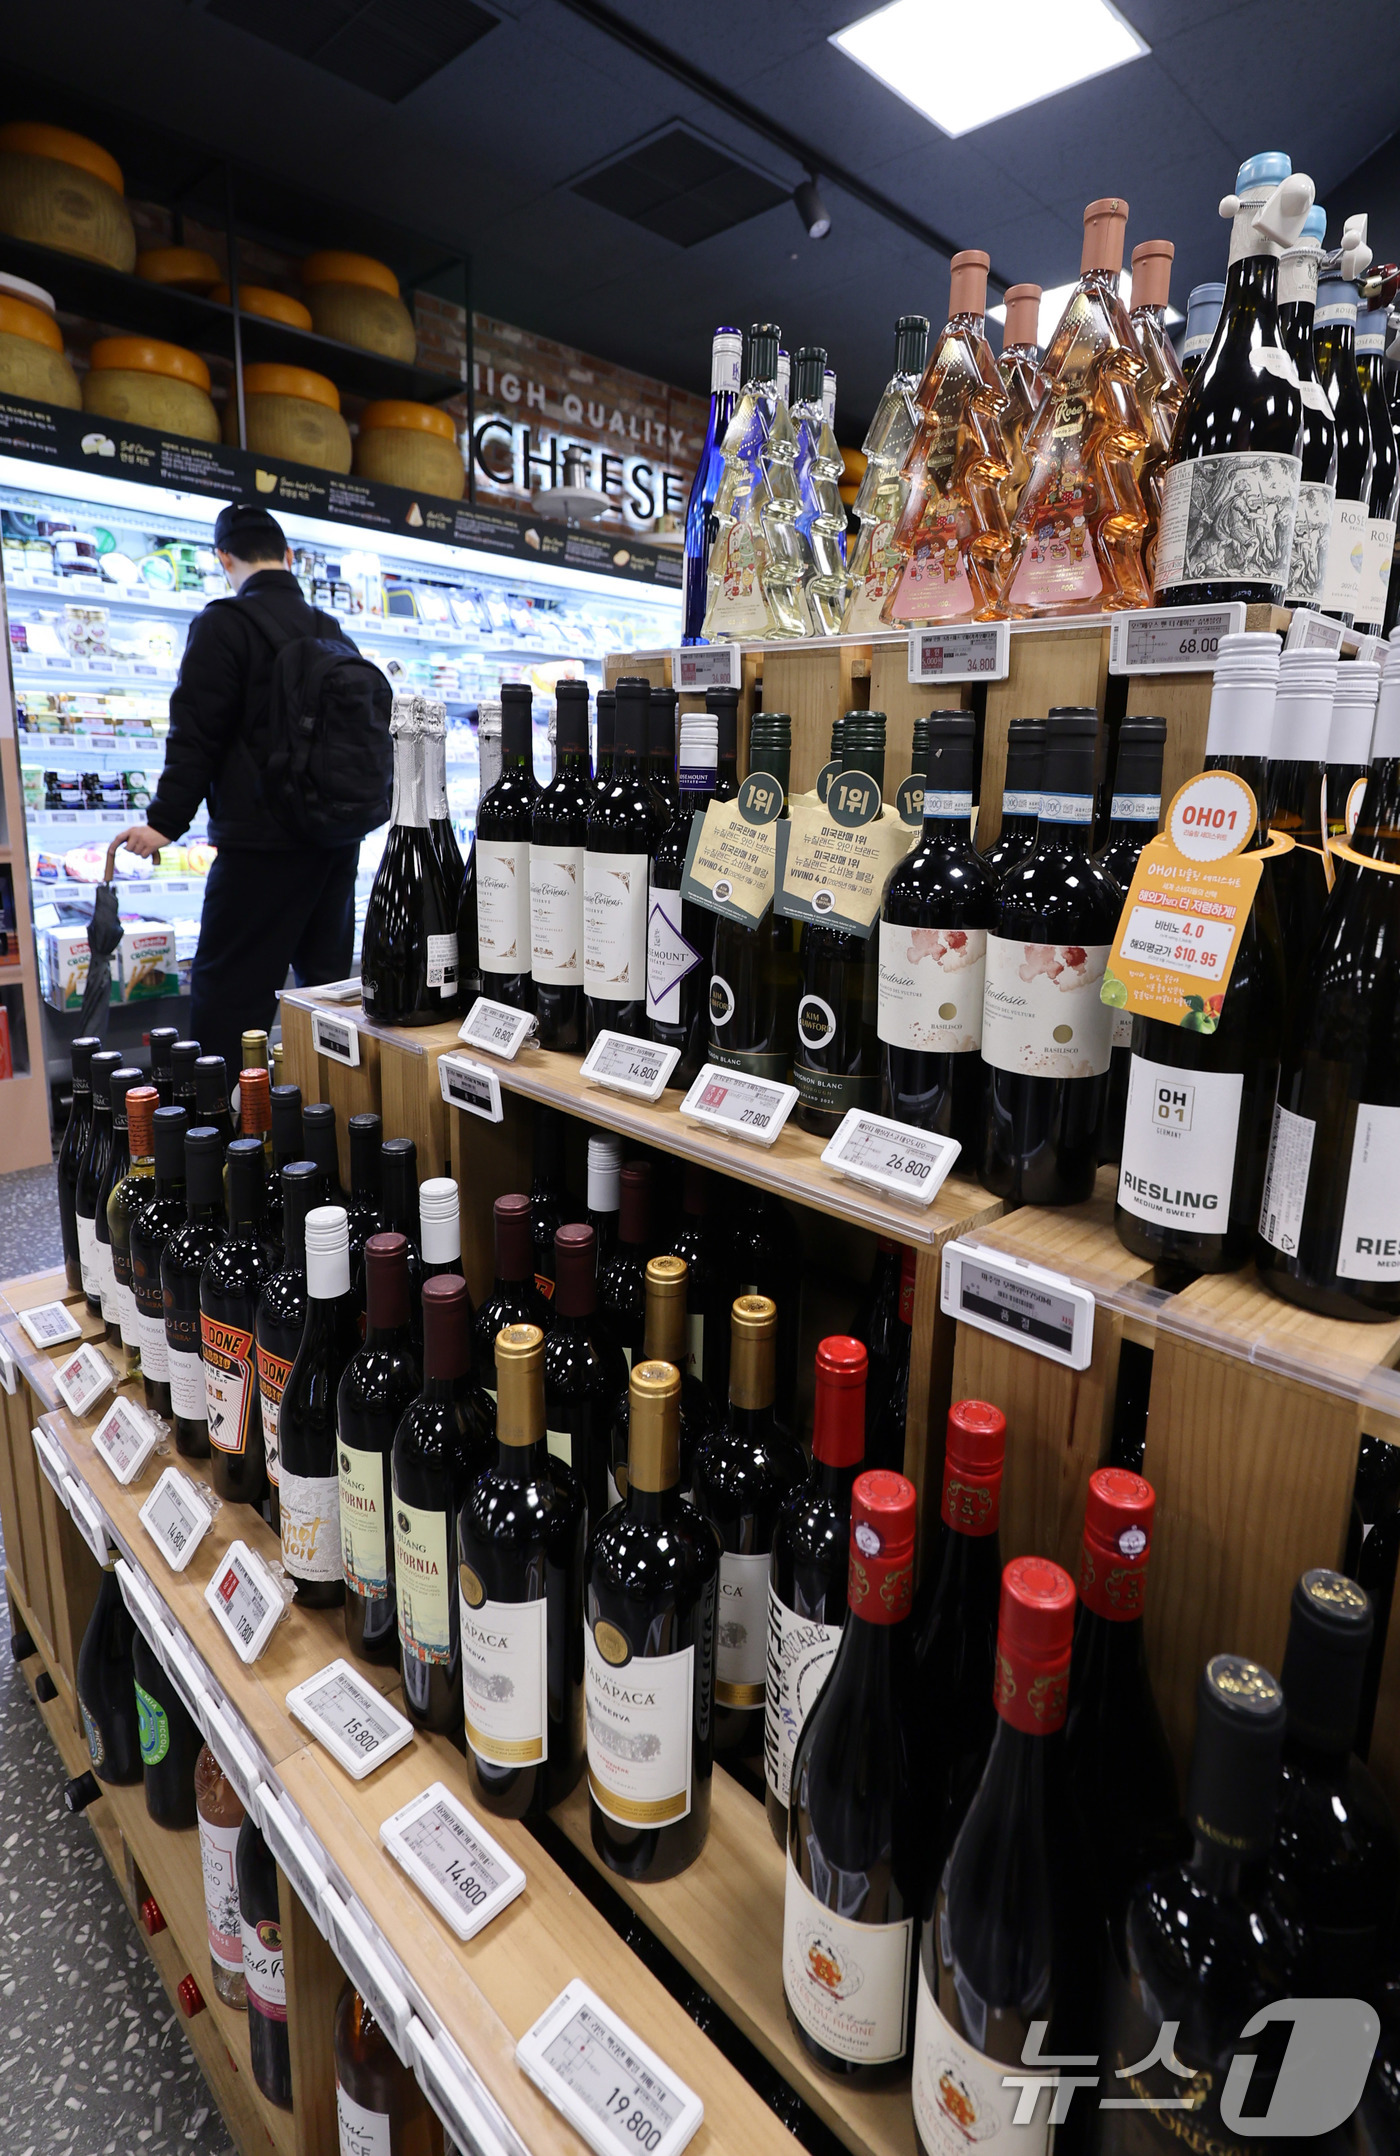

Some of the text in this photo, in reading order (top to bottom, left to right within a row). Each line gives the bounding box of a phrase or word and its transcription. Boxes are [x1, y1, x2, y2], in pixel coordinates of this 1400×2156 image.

[460, 359, 684, 454] HIGH QUALITY
[1179, 637, 1219, 654] 68,00
[967, 657, 996, 672] 34,800
[746, 784, 775, 815] 1위
[837, 785, 870, 815] 1위
[1182, 804, 1239, 831] OH01
[713, 825, 741, 844] 뉴질랜드
[740, 836, 756, 849] 와인
[728, 821, 769, 843] 미국판매 1위
[820, 826, 868, 846] 미국판매 1위
[703, 845, 732, 864] 뉴질랜드
[720, 842, 760, 864] 미국판매 1위
[803, 834, 880, 860] 뉴질랜드 와인 브랜드
[697, 856, 718, 871] VIVINO
[717, 864, 729, 876] 4.0
[794, 855, 828, 873] 뉴질랜드
[813, 850, 861, 869] 미국판매 1위
[790, 868, 814, 881] VIVINO
[814, 873, 827, 885] 4.0
[1179, 897, 1190, 909] 더
[1190, 899, 1237, 920] 저렴하게!
[1154, 919, 1205, 938] 비비노 4.0
[1129, 938, 1218, 967] 해외평균가 $10.95
[805, 1011, 820, 1022] KIM
[720, 1055, 742, 1066] BLANC
[1044, 1046, 1079, 1055] BASILISCO
[628, 1063, 658, 1081] 14,800
[817, 1079, 843, 1090] BLANC
[1158, 1087, 1187, 1107] OH
[740, 1109, 770, 1128] 27,800
[1158, 1104, 1185, 1123] 01
[1156, 1127, 1182, 1139] GERMANY
[886, 1153, 931, 1179] 26,800
[1124, 1170, 1219, 1210] RIESLING
[1133, 1196, 1197, 1219] MEDIUM SWEET
[208, 1326, 245, 1356] DONE
[167, 1521, 187, 1552] 14,800
[280, 1529, 320, 1562] Noir
[235, 1614, 255, 1645] 17,800
[782, 1623, 831, 1668] SQUARE
[594, 1696, 631, 1724] RESERVA
[343, 1717, 380, 1753] 15,800
[444, 1858, 487, 1906] 14,800
[606, 2086, 662, 2152] 19,800
